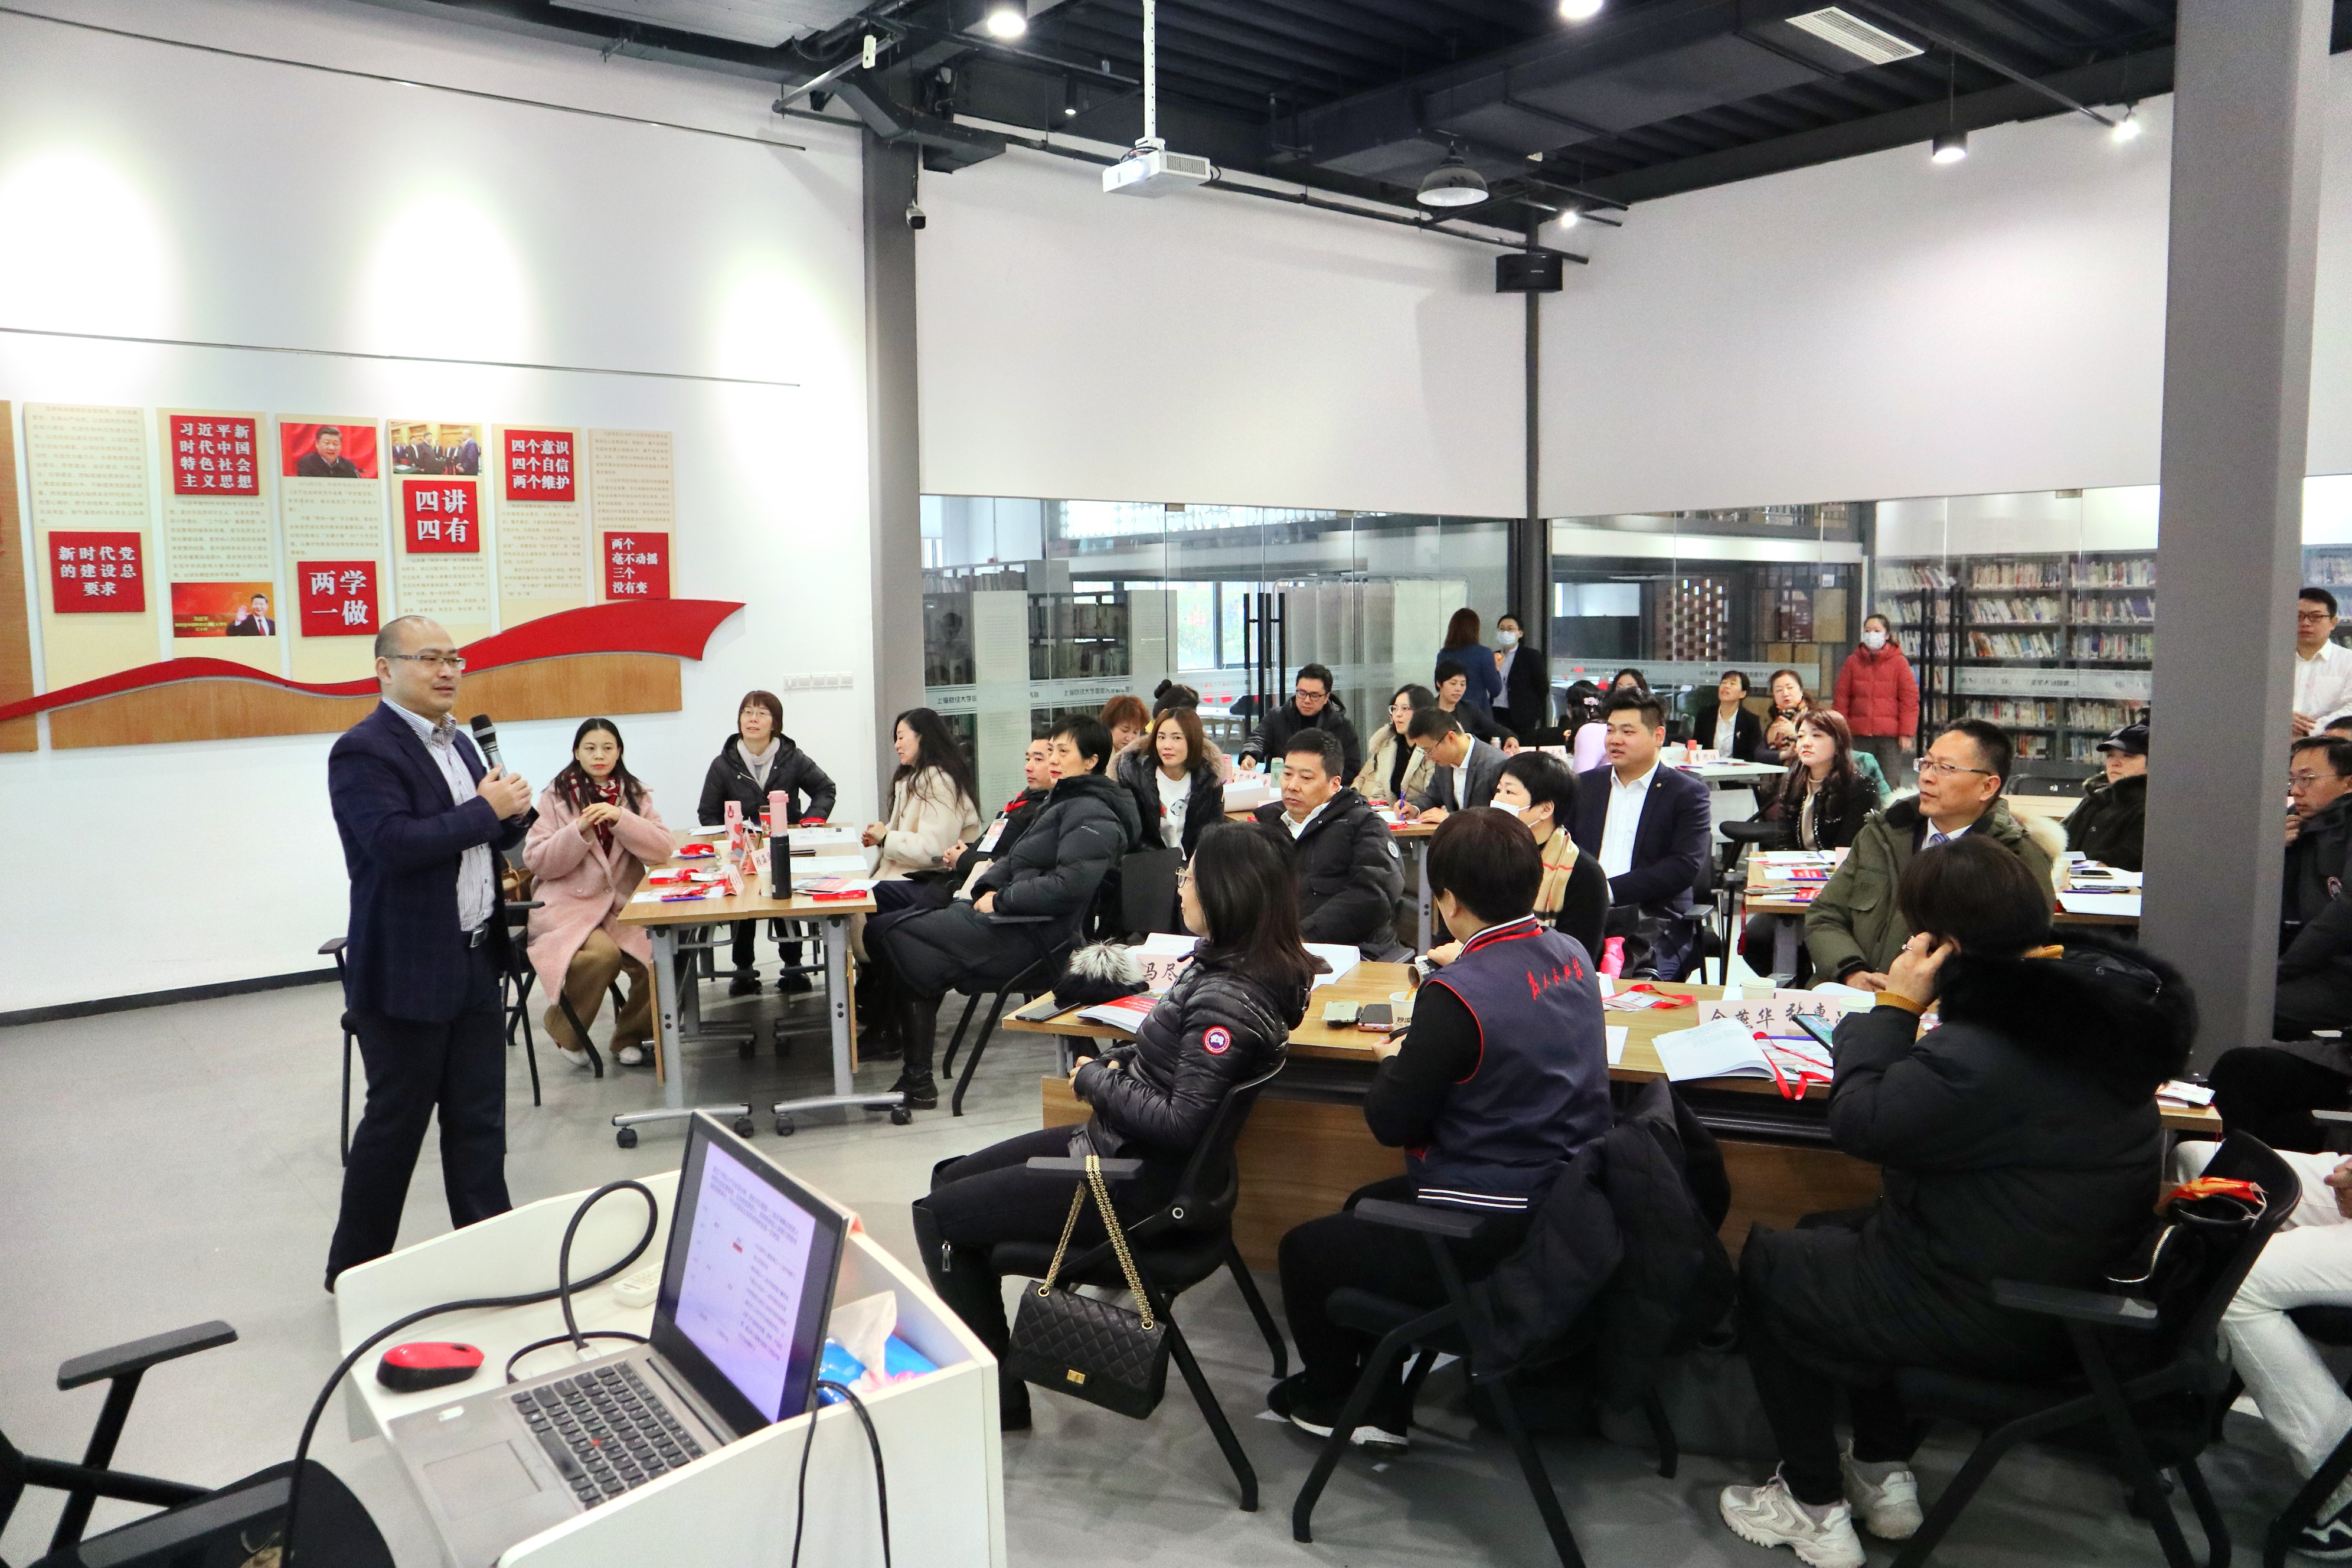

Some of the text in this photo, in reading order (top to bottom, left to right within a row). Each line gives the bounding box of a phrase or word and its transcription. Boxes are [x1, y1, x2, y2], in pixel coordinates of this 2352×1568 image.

[179, 422, 250, 439] 习近平新
[179, 439, 250, 455] 时代中国
[511, 439, 570, 455] 四个意识
[180, 456, 251, 472] 特色社会
[512, 456, 569, 473] 四个自信
[182, 473, 253, 489] 主义思想
[512, 474, 570, 490] 两个维护
[415, 489, 468, 514] 四讲
[417, 517, 469, 543] 四有
[610, 537, 635, 550] 两个
[58, 545, 135, 561] 新时代党
[612, 552, 658, 565] 毫不动摇
[60, 563, 136, 579] 的建设总
[612, 567, 635, 580] 三个
[83, 581, 117, 596] 要求
[309, 570, 367, 596] 两学
[612, 581, 648, 594] 没有变
[312, 600, 369, 626] 一做
